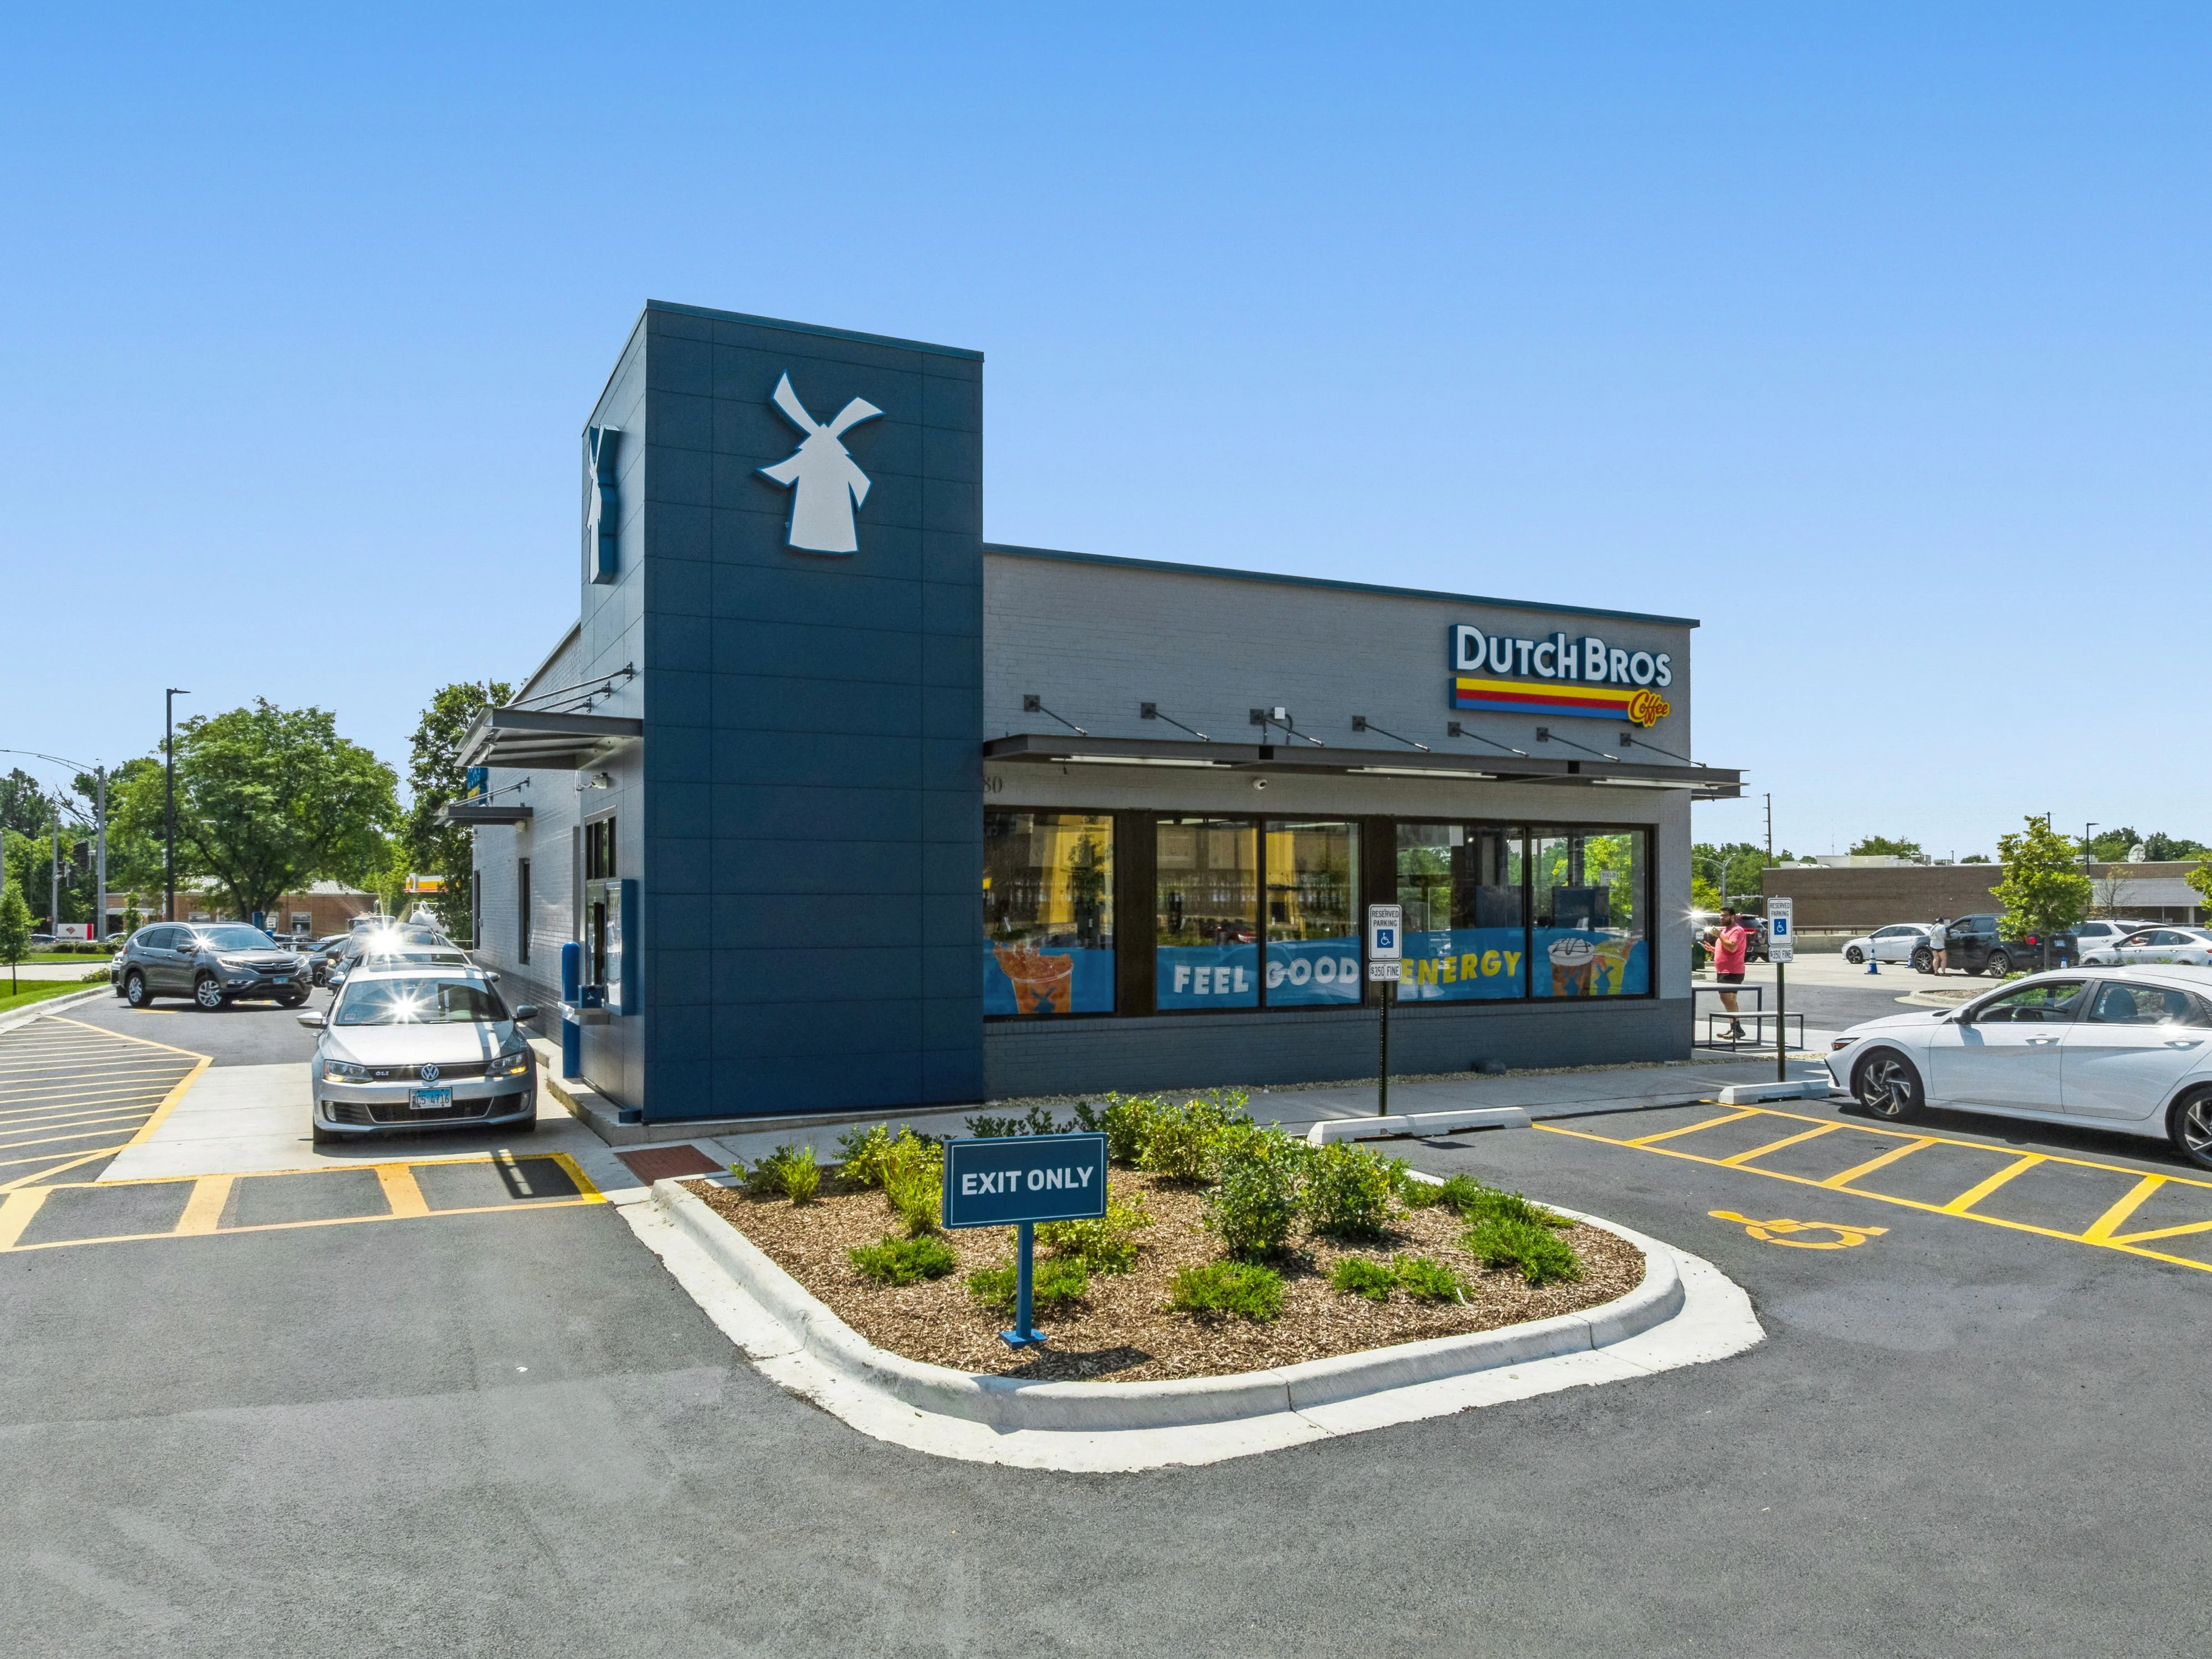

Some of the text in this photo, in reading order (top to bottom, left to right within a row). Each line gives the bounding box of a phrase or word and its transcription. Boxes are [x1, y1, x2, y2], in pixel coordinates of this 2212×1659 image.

[1584, 637, 1672, 687] BROS
[1629, 691, 1670, 726] Coffee
[1770, 950, 1792, 959] $350 FINE
[1173, 949, 1522, 995] FEEL GOOD ENERGY
[1371, 966, 1399, 976] $350 FINE
[430, 1094, 449, 1104] 4716
[962, 1166, 1094, 1195] EXIT ONLY
